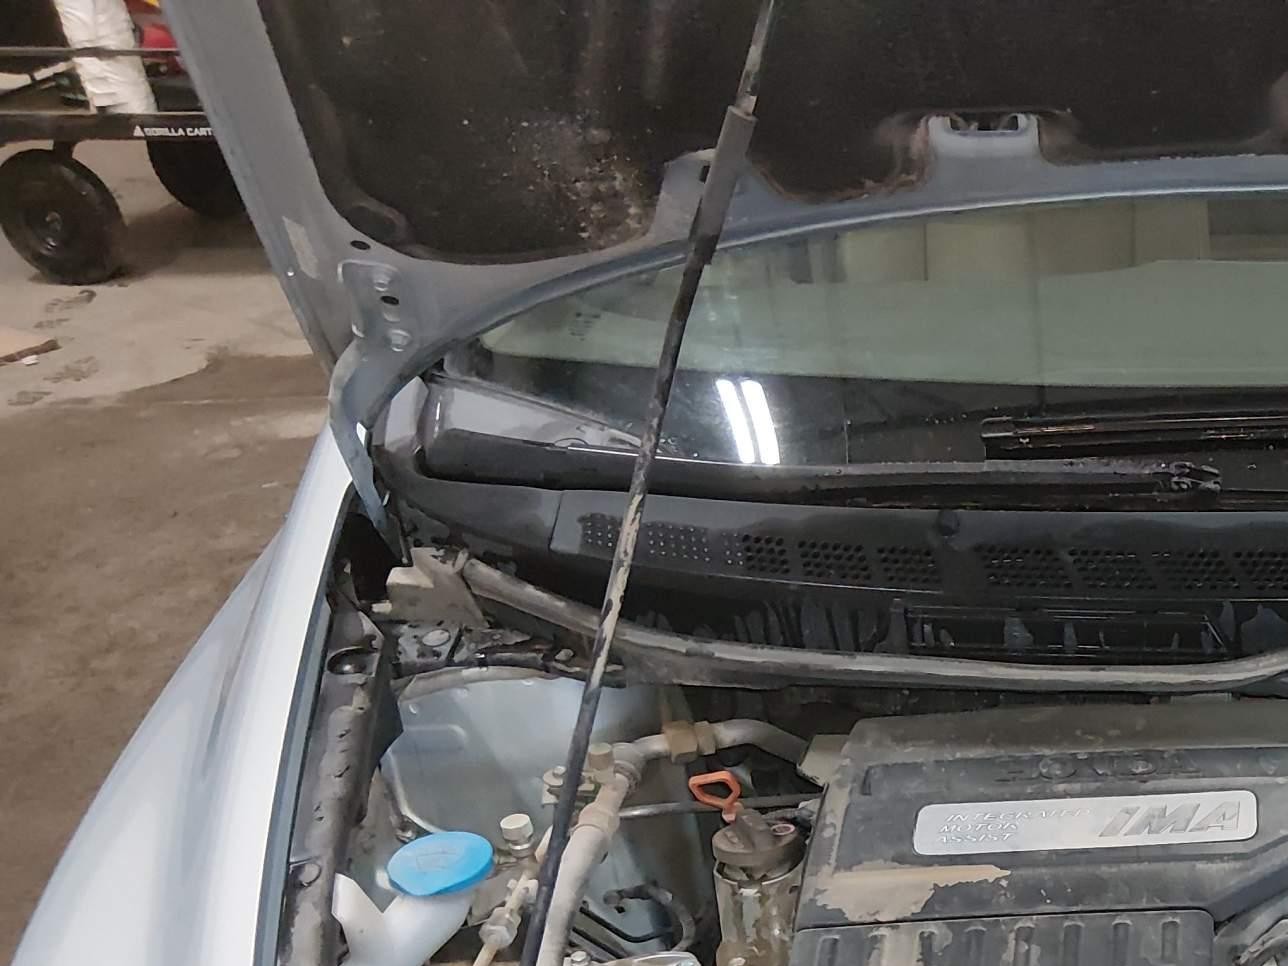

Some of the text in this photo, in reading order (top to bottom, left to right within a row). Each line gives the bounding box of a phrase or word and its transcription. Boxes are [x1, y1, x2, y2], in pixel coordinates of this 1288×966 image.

[1098, 800, 1241, 838] IMA
[938, 822, 1019, 834] MOTOR
[937, 832, 1014, 844] ASSIST
